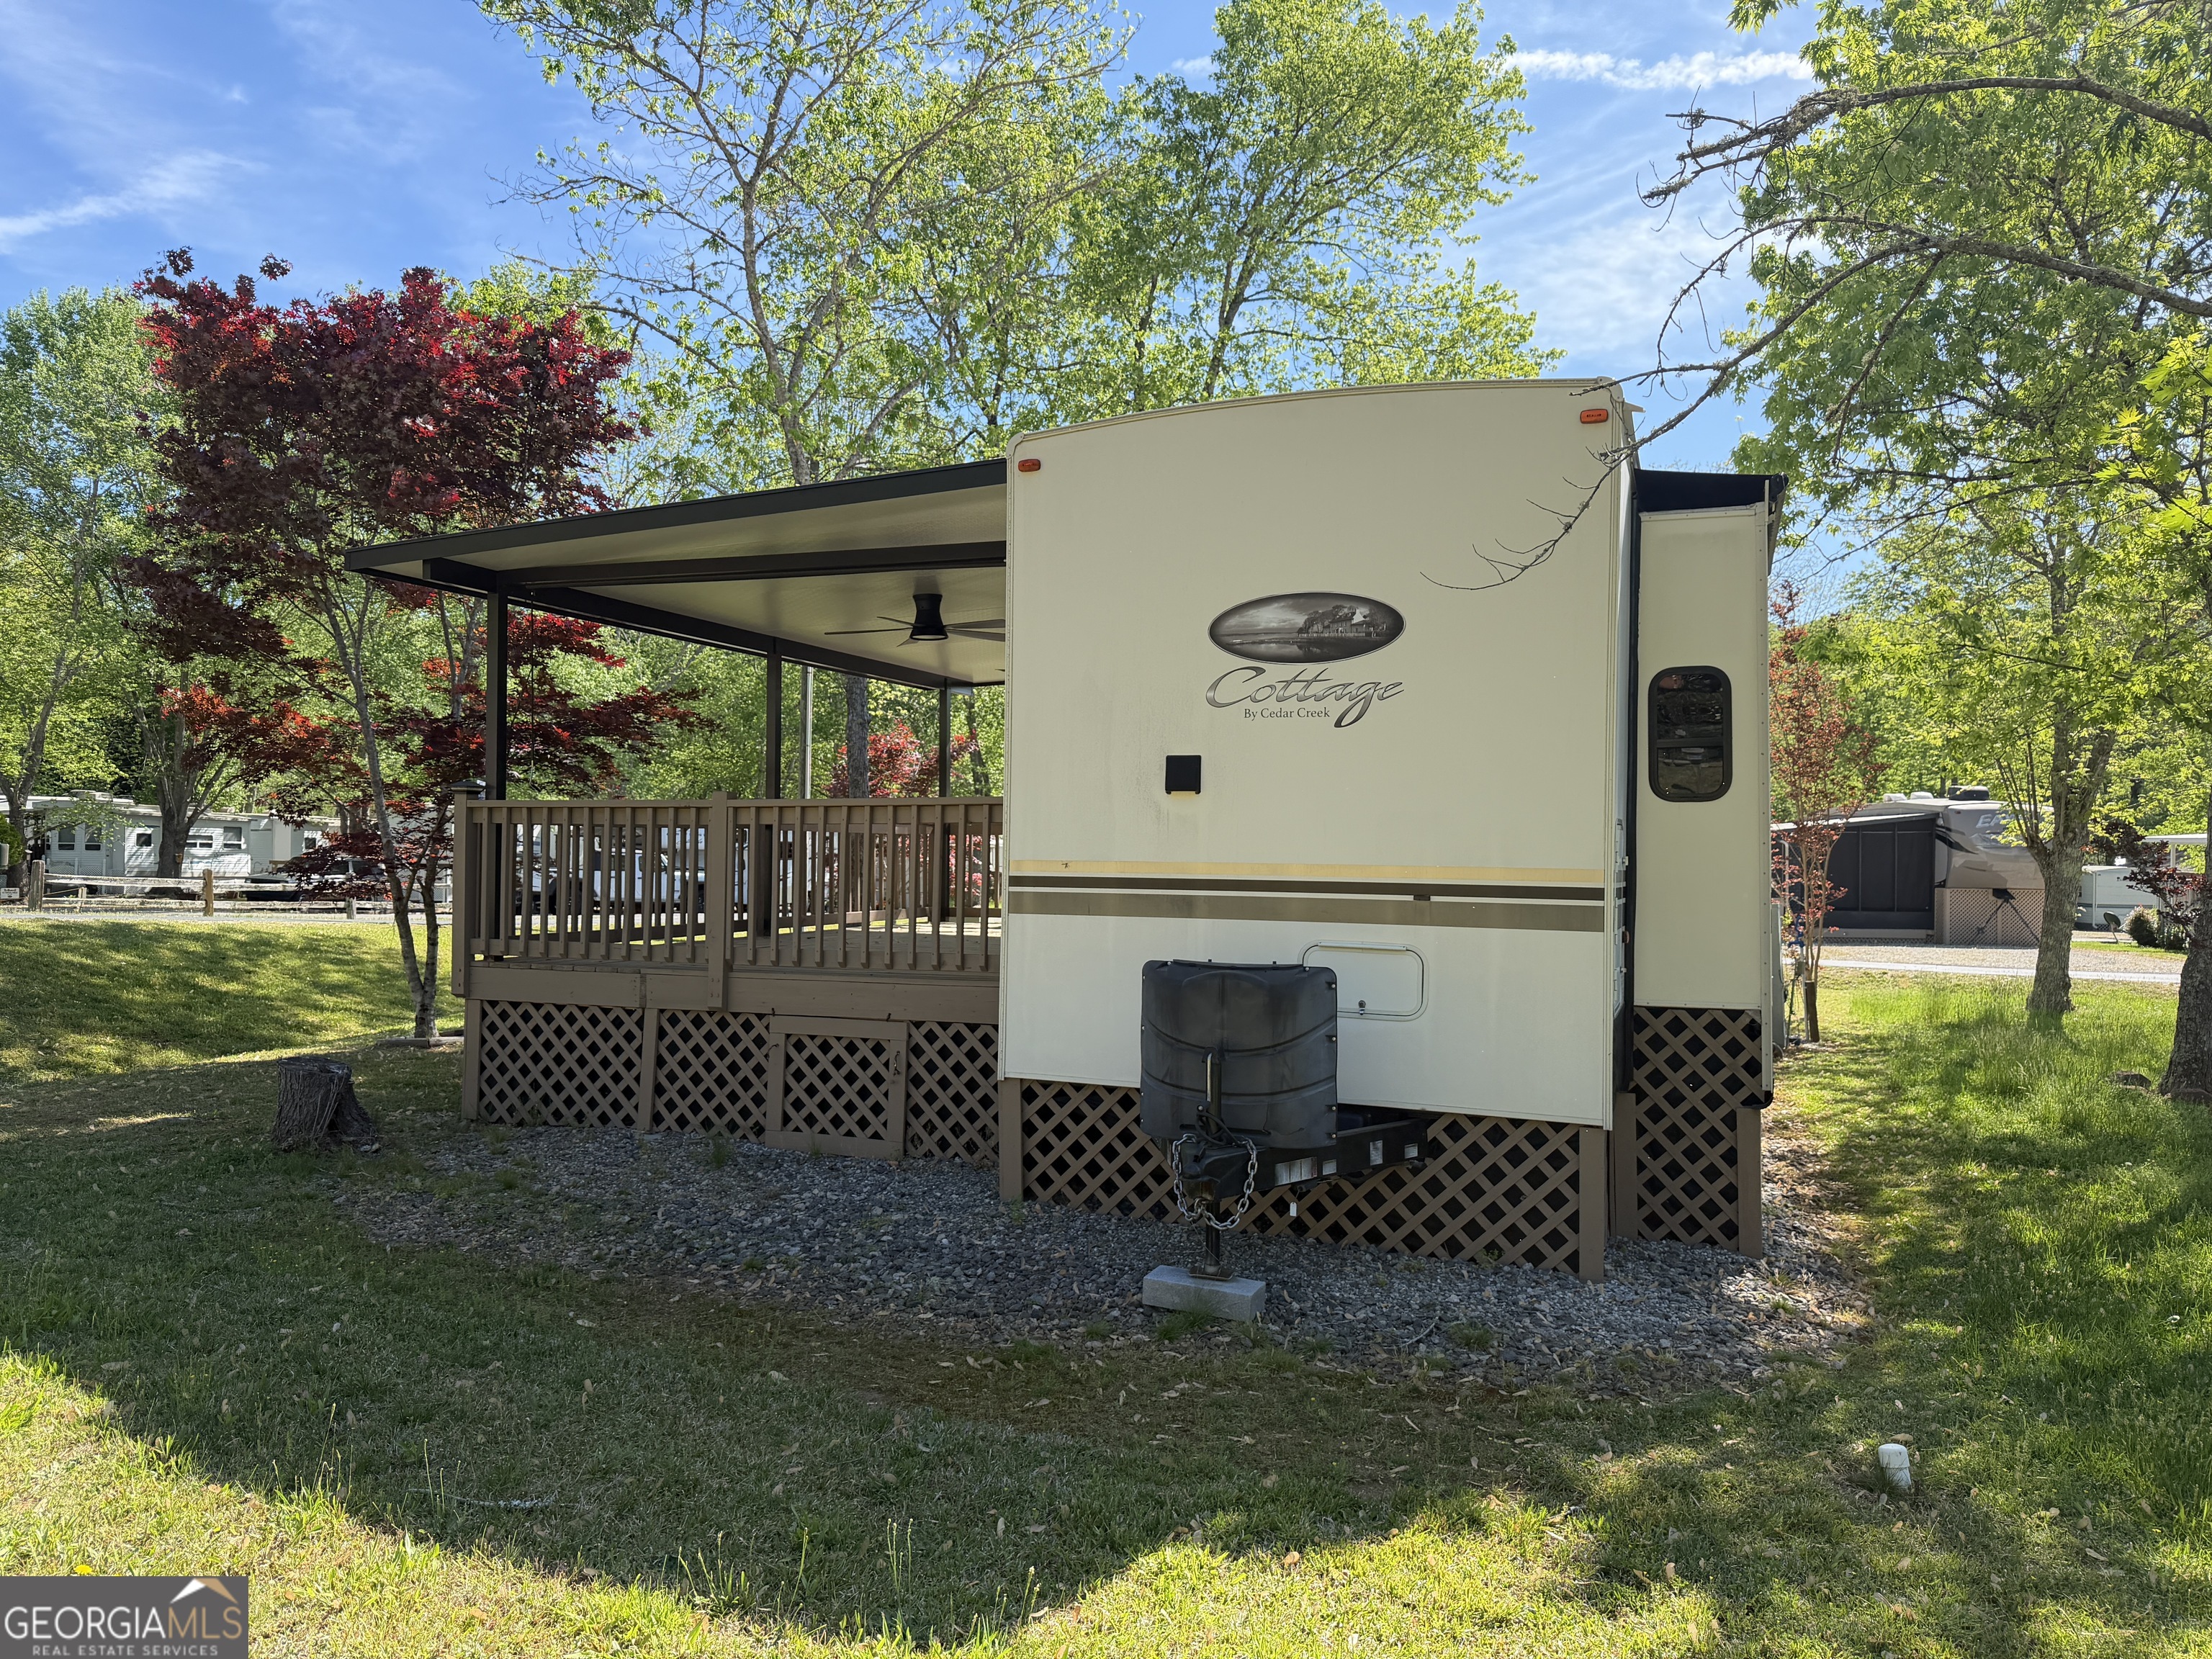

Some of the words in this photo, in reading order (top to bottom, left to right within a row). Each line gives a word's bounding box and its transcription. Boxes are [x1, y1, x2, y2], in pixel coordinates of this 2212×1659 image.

[1206, 666, 1405, 728] Cottage
[1244, 709, 1258, 721] By
[1261, 707, 1295, 719] Cedar
[1297, 706, 1331, 718] Creek
